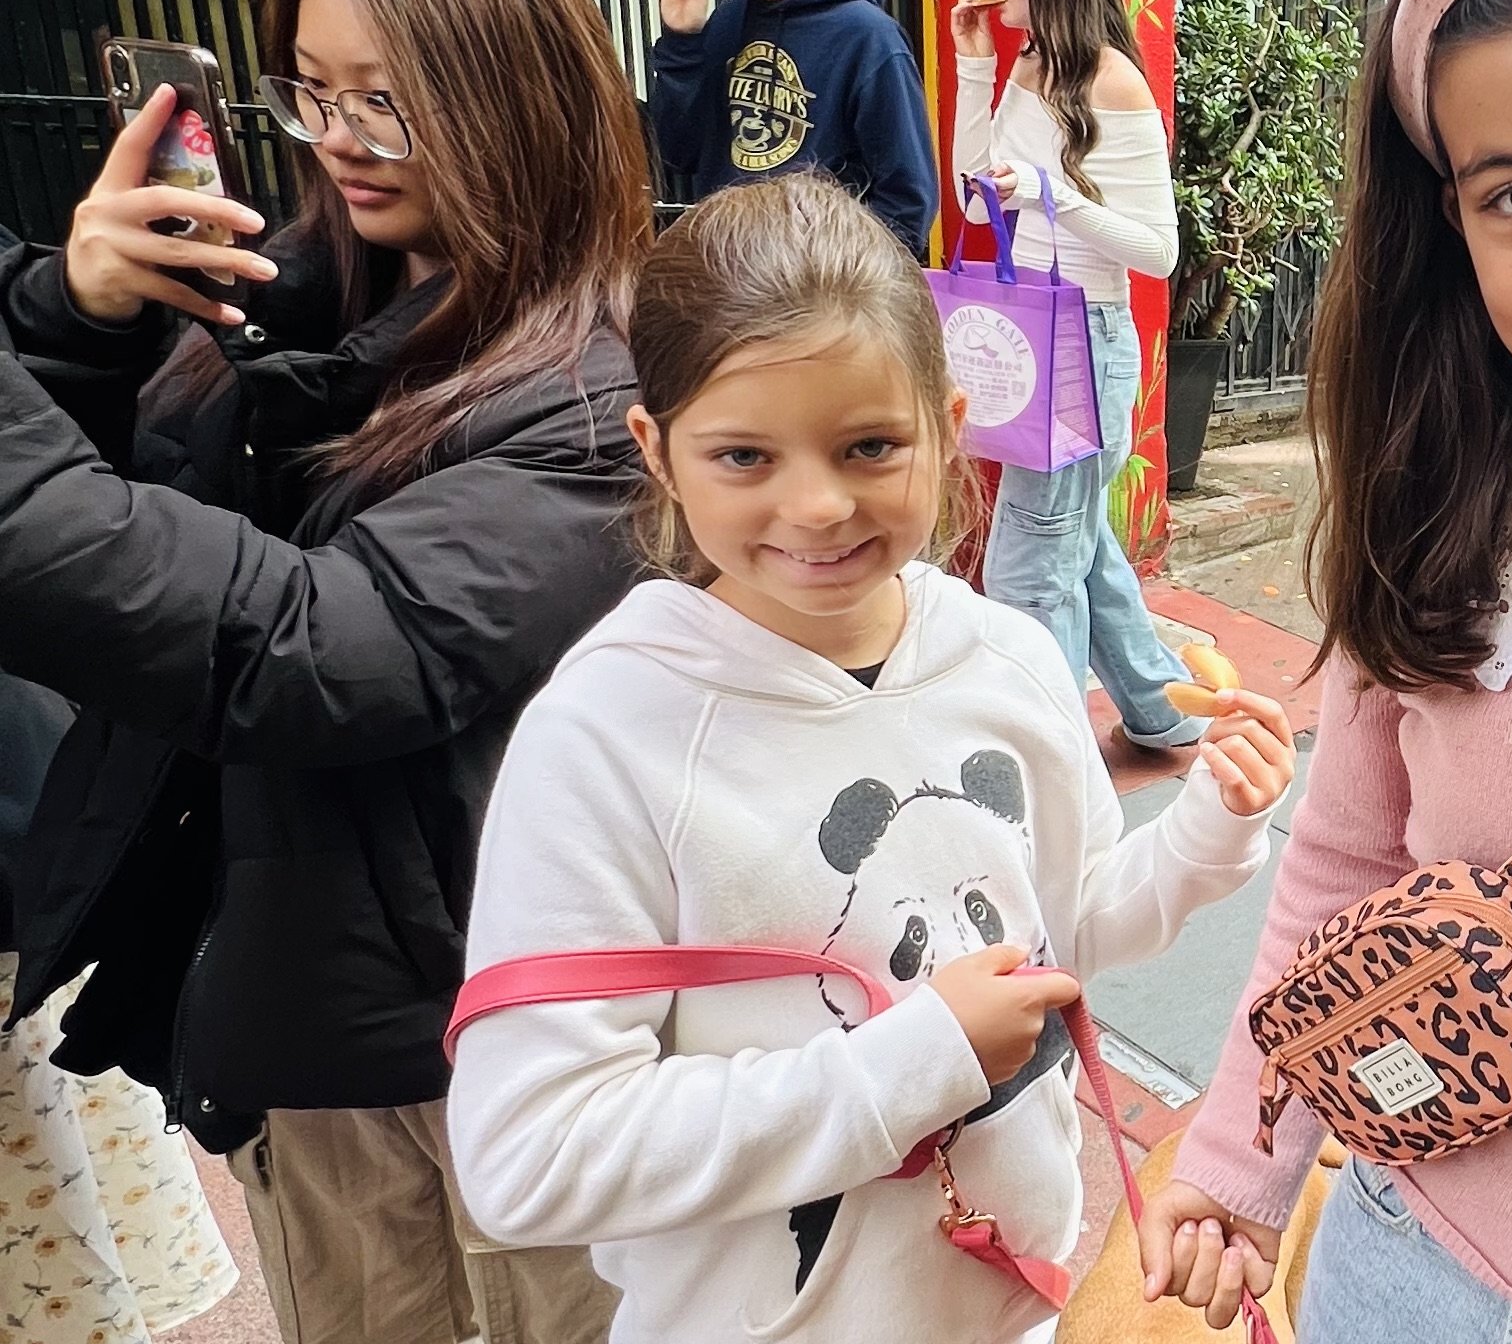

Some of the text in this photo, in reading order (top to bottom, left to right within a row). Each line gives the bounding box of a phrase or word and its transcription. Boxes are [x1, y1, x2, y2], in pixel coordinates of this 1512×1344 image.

[945, 308, 1032, 357] GOLDEN GATE
[1371, 1057, 1414, 1084] BILLA
[1385, 1071, 1423, 1097] BONG
